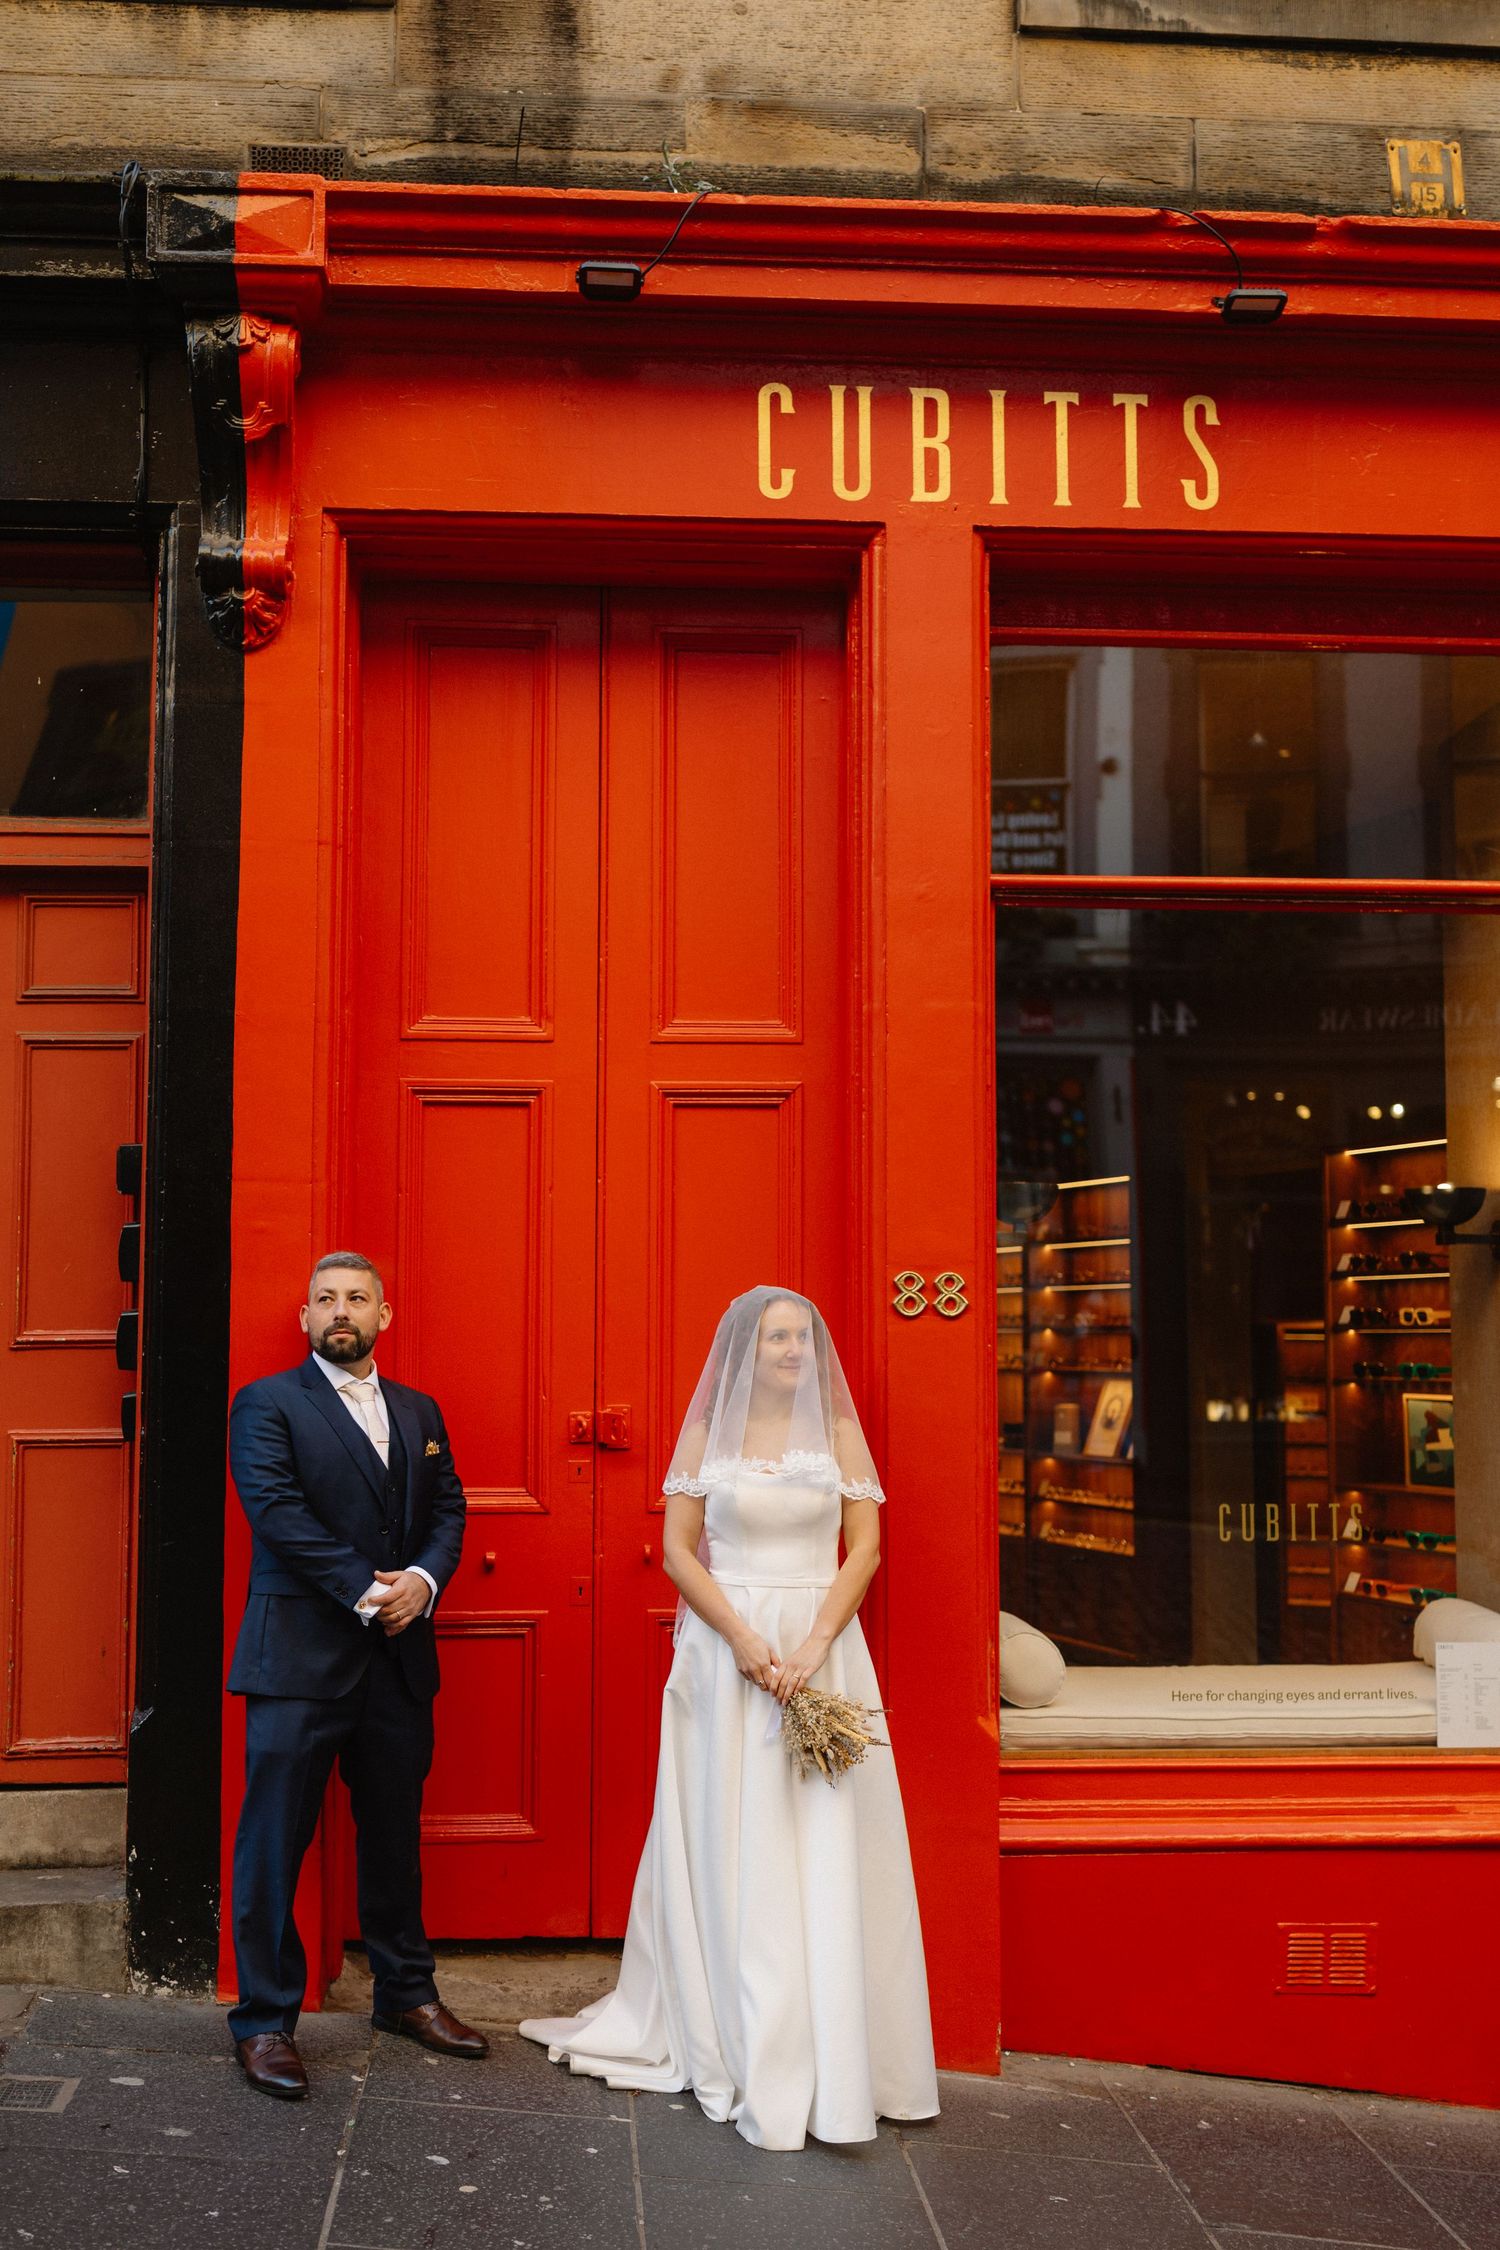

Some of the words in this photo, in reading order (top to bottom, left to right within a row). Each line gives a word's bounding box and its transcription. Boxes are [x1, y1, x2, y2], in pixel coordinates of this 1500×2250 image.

[1419, 186, 1438, 203] 15
[757, 382, 1221, 511] CUBITTS
[893, 1270, 969, 1317] 88
[1218, 1503, 1363, 1542] CUBITTS
[1171, 1690, 1203, 1702] Here
[1206, 1690, 1225, 1702] for
[1227, 1689, 1284, 1704] changing
[1286, 1691, 1315, 1704] eyes
[1317, 1689, 1341, 1701] and
[1343, 1689, 1384, 1700] errant
[1386, 1688, 1418, 1700] lives.
